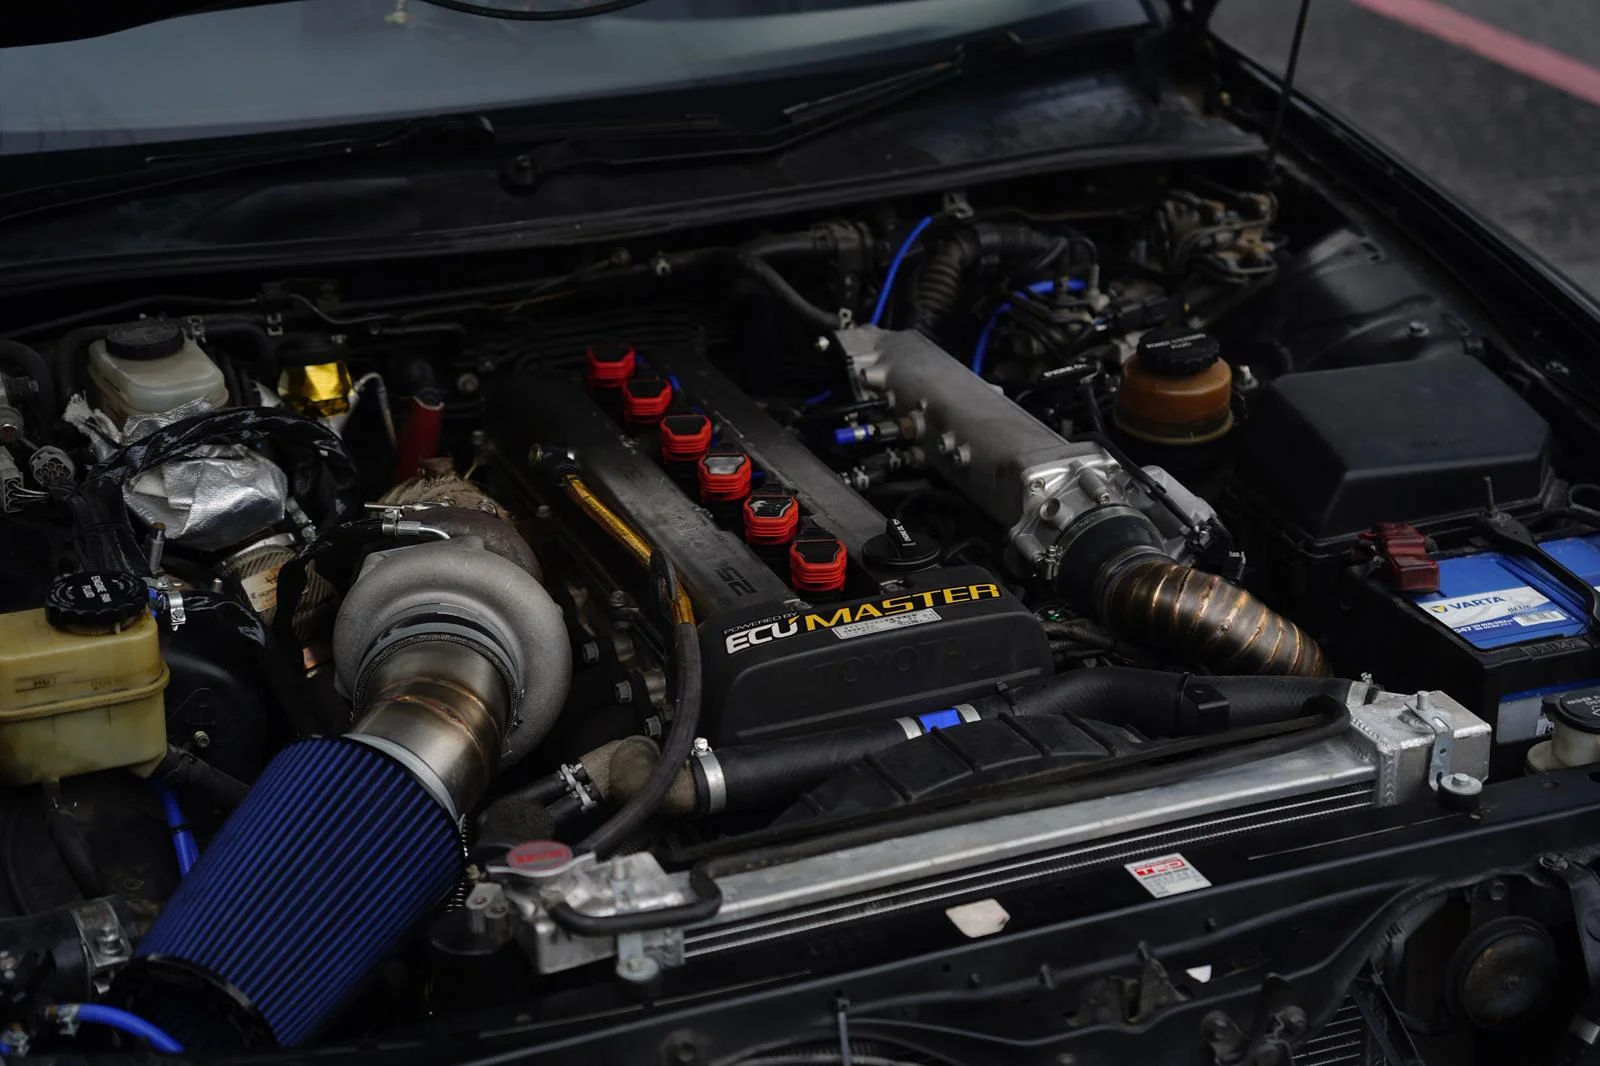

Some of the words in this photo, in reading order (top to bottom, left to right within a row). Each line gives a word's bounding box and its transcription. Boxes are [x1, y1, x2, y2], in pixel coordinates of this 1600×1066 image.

[1448, 596, 1505, 609] VARTA
[724, 614, 782, 636] POWERED
[780, 611, 798, 623] BY
